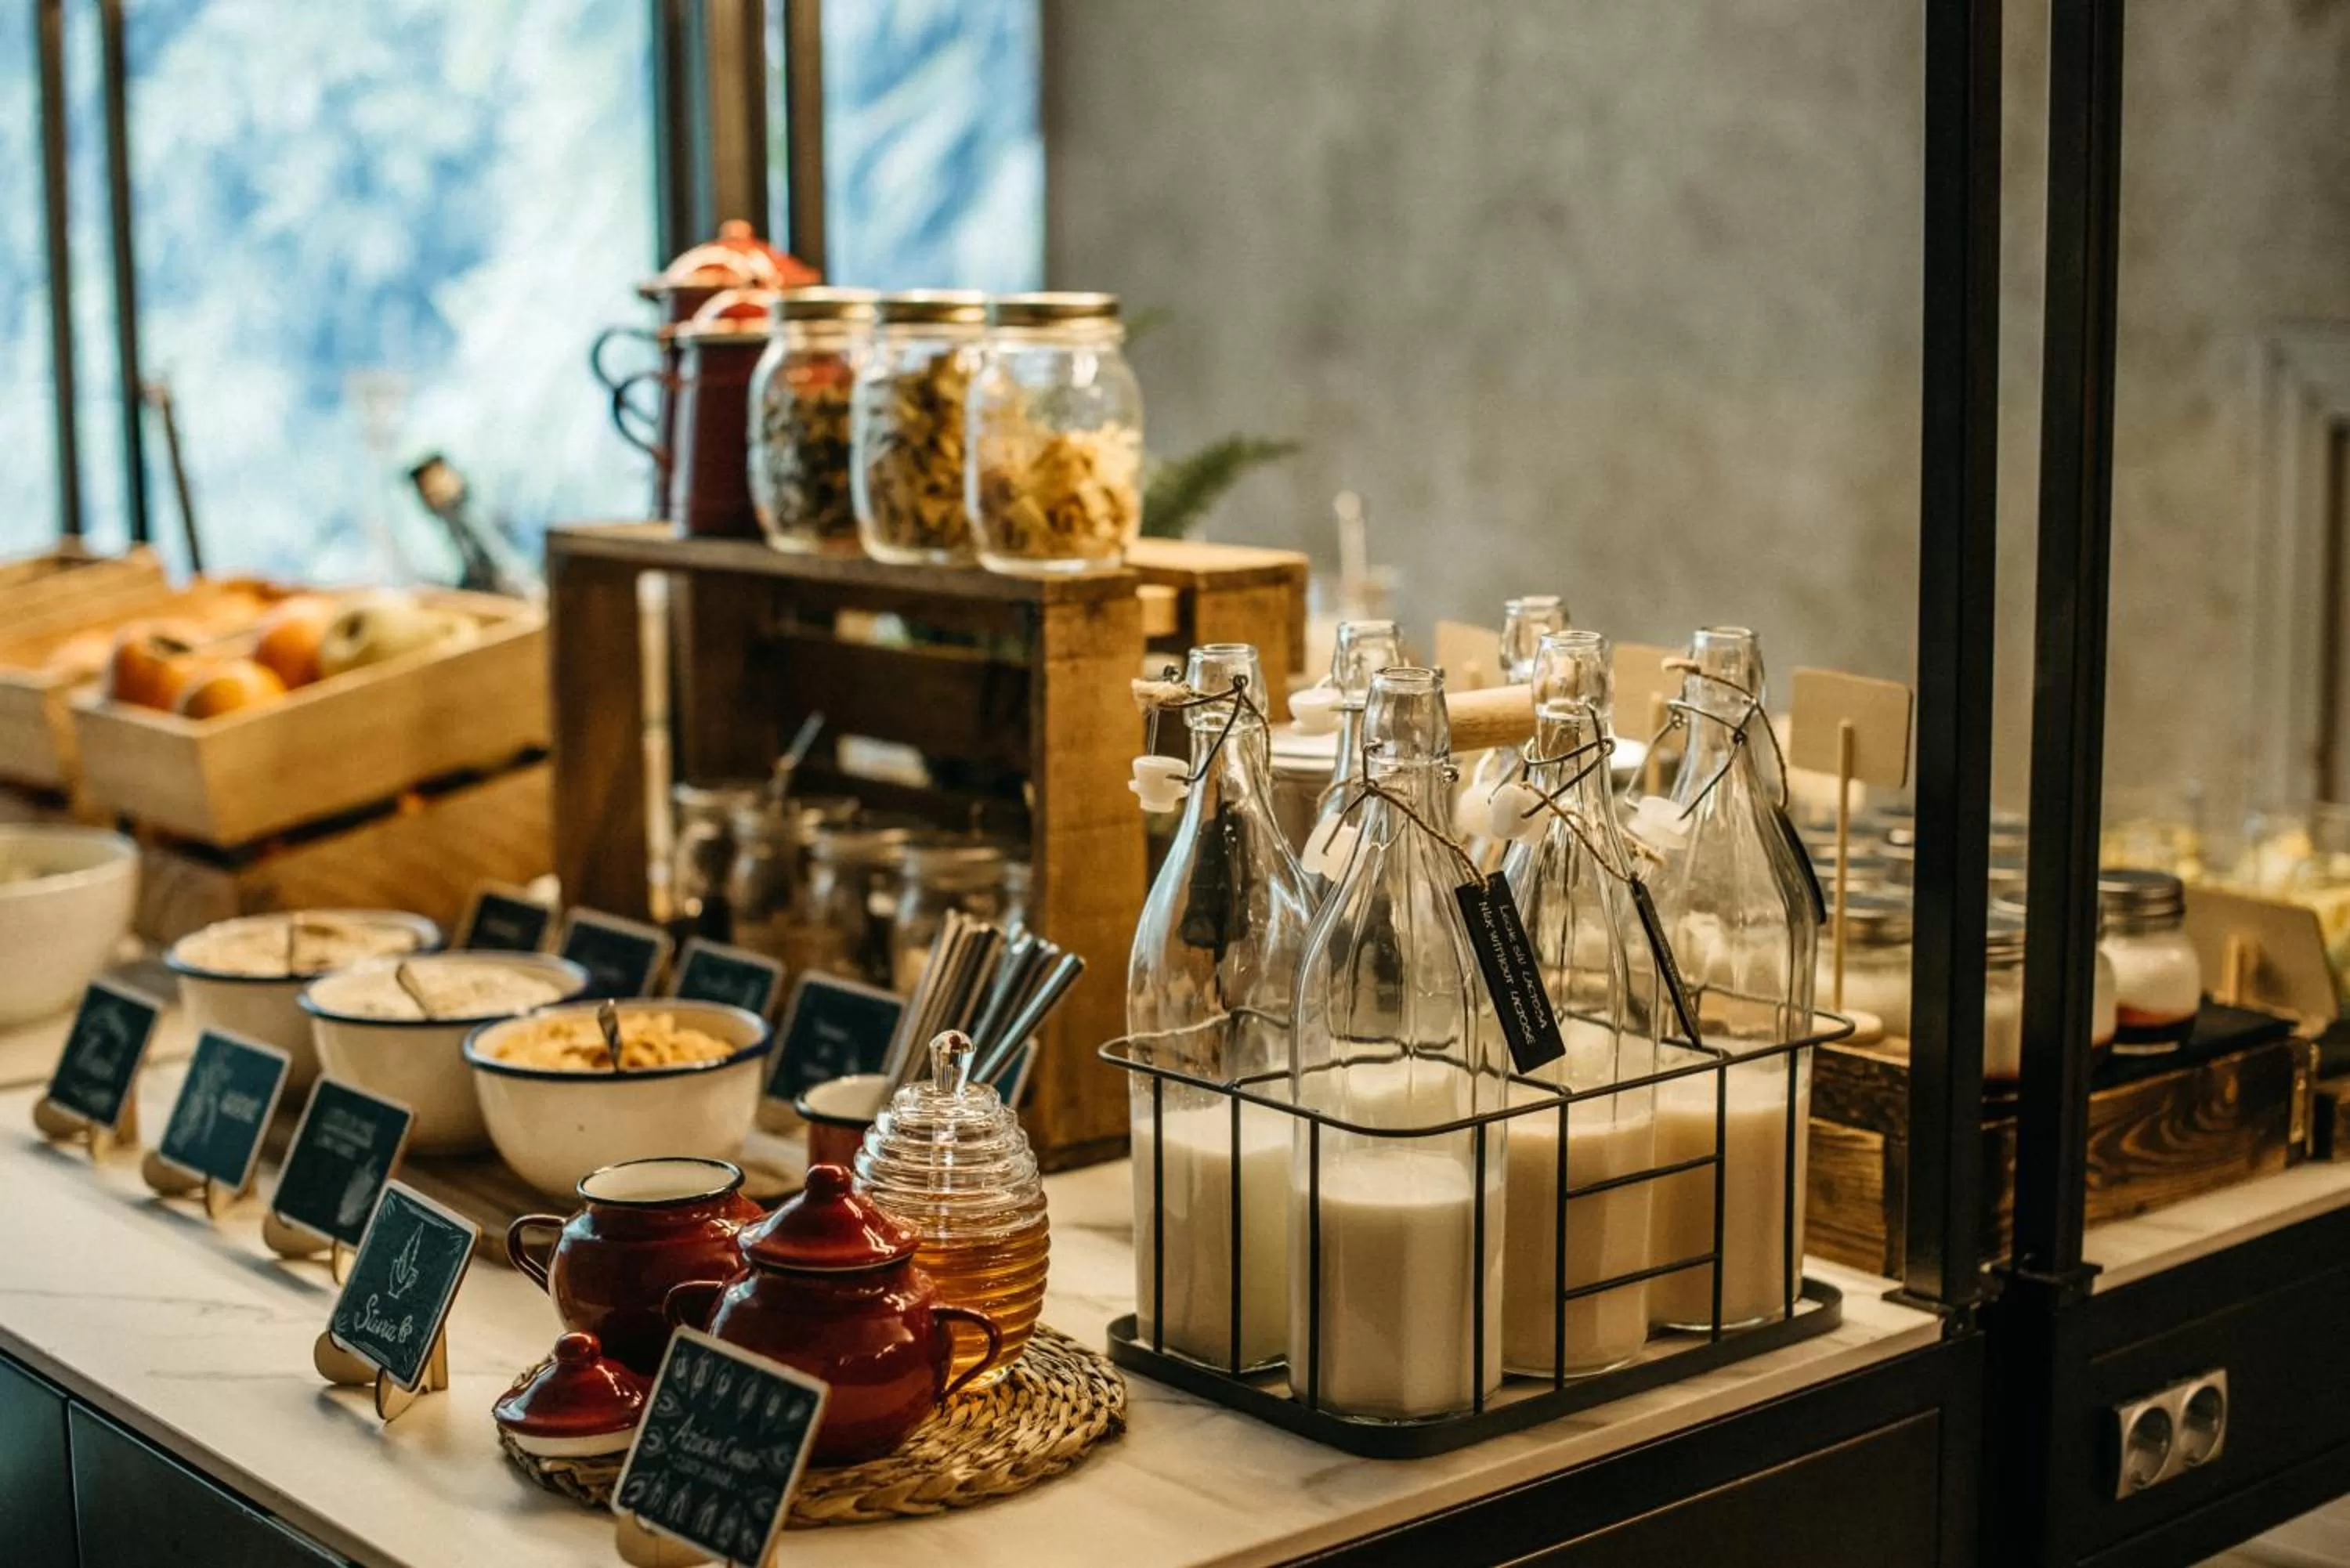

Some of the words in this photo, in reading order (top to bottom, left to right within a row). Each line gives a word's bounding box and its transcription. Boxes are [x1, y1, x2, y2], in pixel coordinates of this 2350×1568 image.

[1491, 931, 1514, 985] WITHOUT
[1511, 990, 1535, 1045] LACTOSE
[1523, 971, 1547, 1029] LACTOSA
